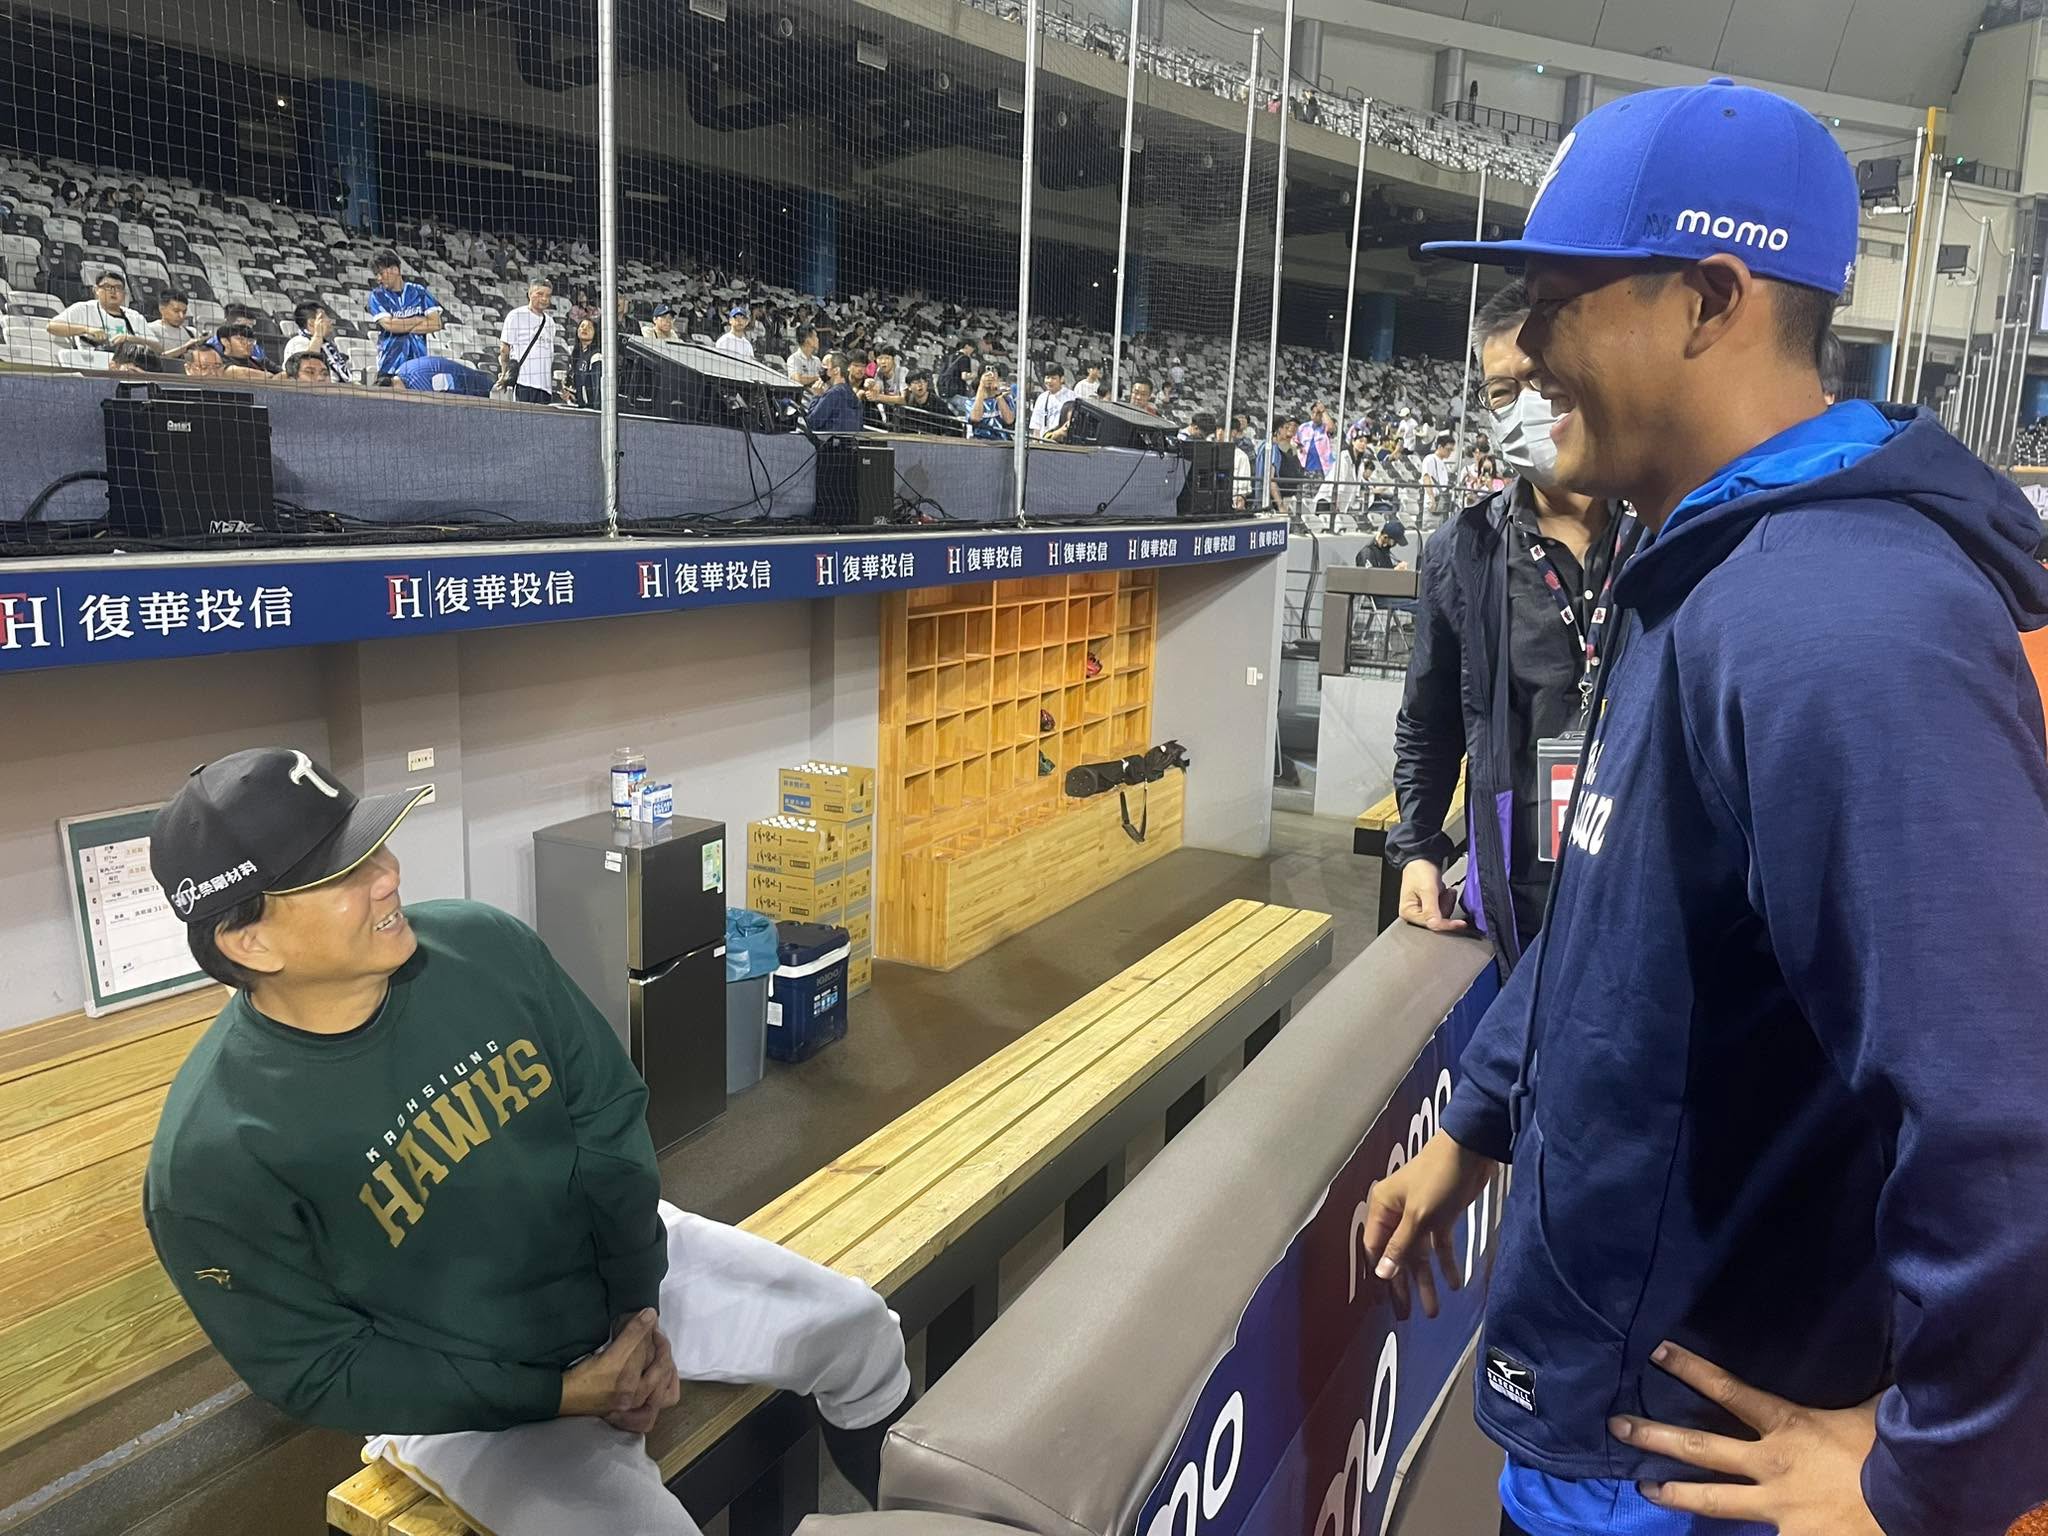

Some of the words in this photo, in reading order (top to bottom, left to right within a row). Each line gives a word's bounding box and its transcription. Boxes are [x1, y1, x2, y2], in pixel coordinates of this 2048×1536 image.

[1676, 208, 1789, 251] momo
[967, 545, 1023, 572] 復華投信
[1063, 541, 1109, 565] 復華投信
[1140, 538, 1177, 559] 復華投信
[1204, 535, 1236, 554] 復華投信
[674, 560, 772, 595] 復華投信
[842, 552, 915, 583] 復華投信
[434, 570, 575, 615] 復華投信
[78, 586, 294, 642] 復華投信
[365, 1040, 499, 1163] KAOHSIUNG
[359, 1039, 552, 1248] HAWKS
